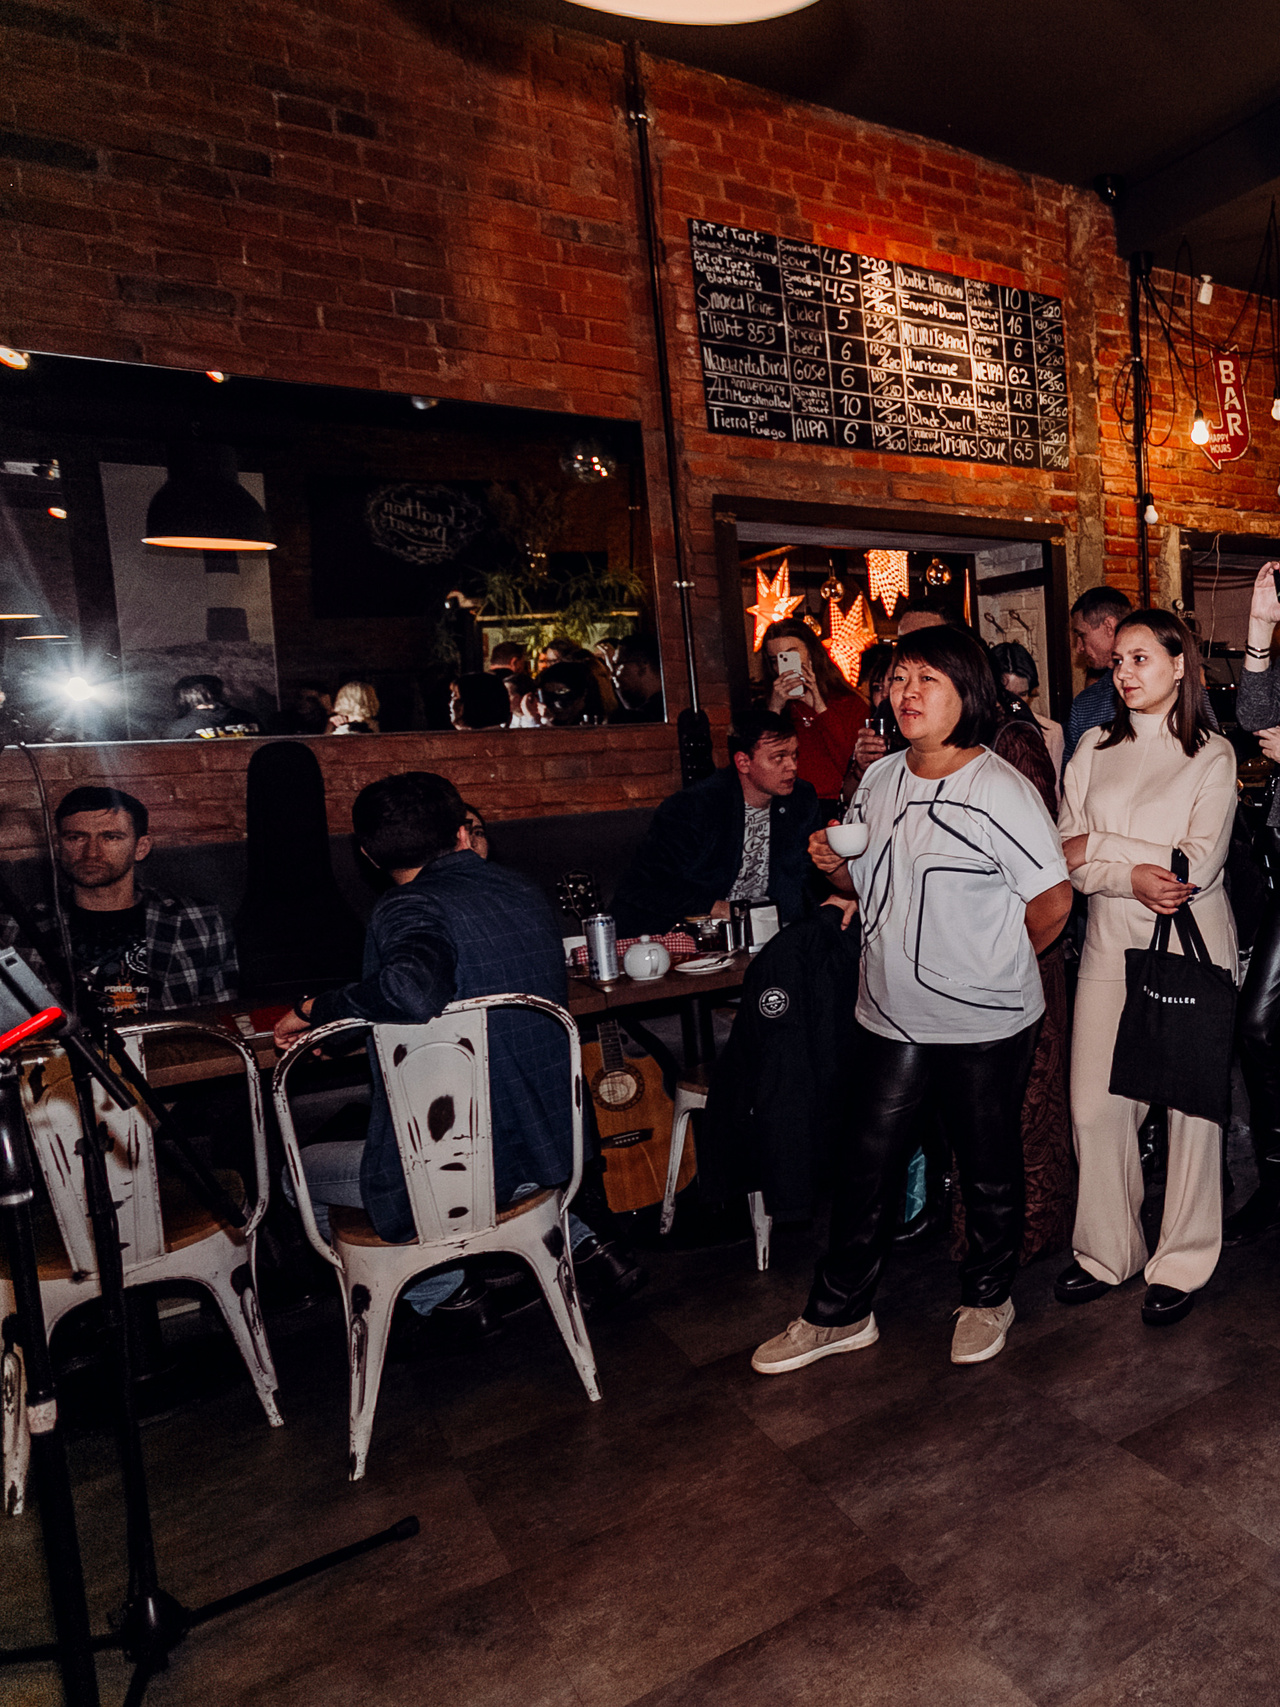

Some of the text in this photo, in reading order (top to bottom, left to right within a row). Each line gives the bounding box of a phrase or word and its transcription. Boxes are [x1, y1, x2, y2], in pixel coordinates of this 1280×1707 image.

[823, 248, 852, 275] 4,5
[706, 272, 762, 291] Blackberry
[897, 266, 928, 291] Double
[825, 279, 857, 304] 4,5
[1005, 287, 1022, 310] 10
[787, 301, 822, 324] Cider
[837, 309, 852, 330] 5
[700, 311, 776, 345] Flight 859
[971, 318, 998, 333] Stout
[1006, 315, 1023, 335] 16
[841, 341, 853, 360] 6
[974, 343, 993, 358] Ale
[1014, 341, 1023, 359] 6
[903, 347, 958, 377] Hurricane
[973, 361, 1003, 382] NEIPA
[840, 367, 855, 388] 6
[840, 394, 862, 416] 10
[978, 394, 1008, 413] Lager
[1218, 360, 1244, 436] BAR
[709, 406, 787, 440] Tierra Del Fuego
[908, 404, 972, 432] Black Swell
[1016, 419, 1031, 438] 12
[844, 422, 859, 445] 6
[980, 424, 1010, 438] Stout
[1209, 433, 1229, 443] HAPPY
[940, 431, 977, 458] Origins
[1210, 443, 1232, 453] HOURS
